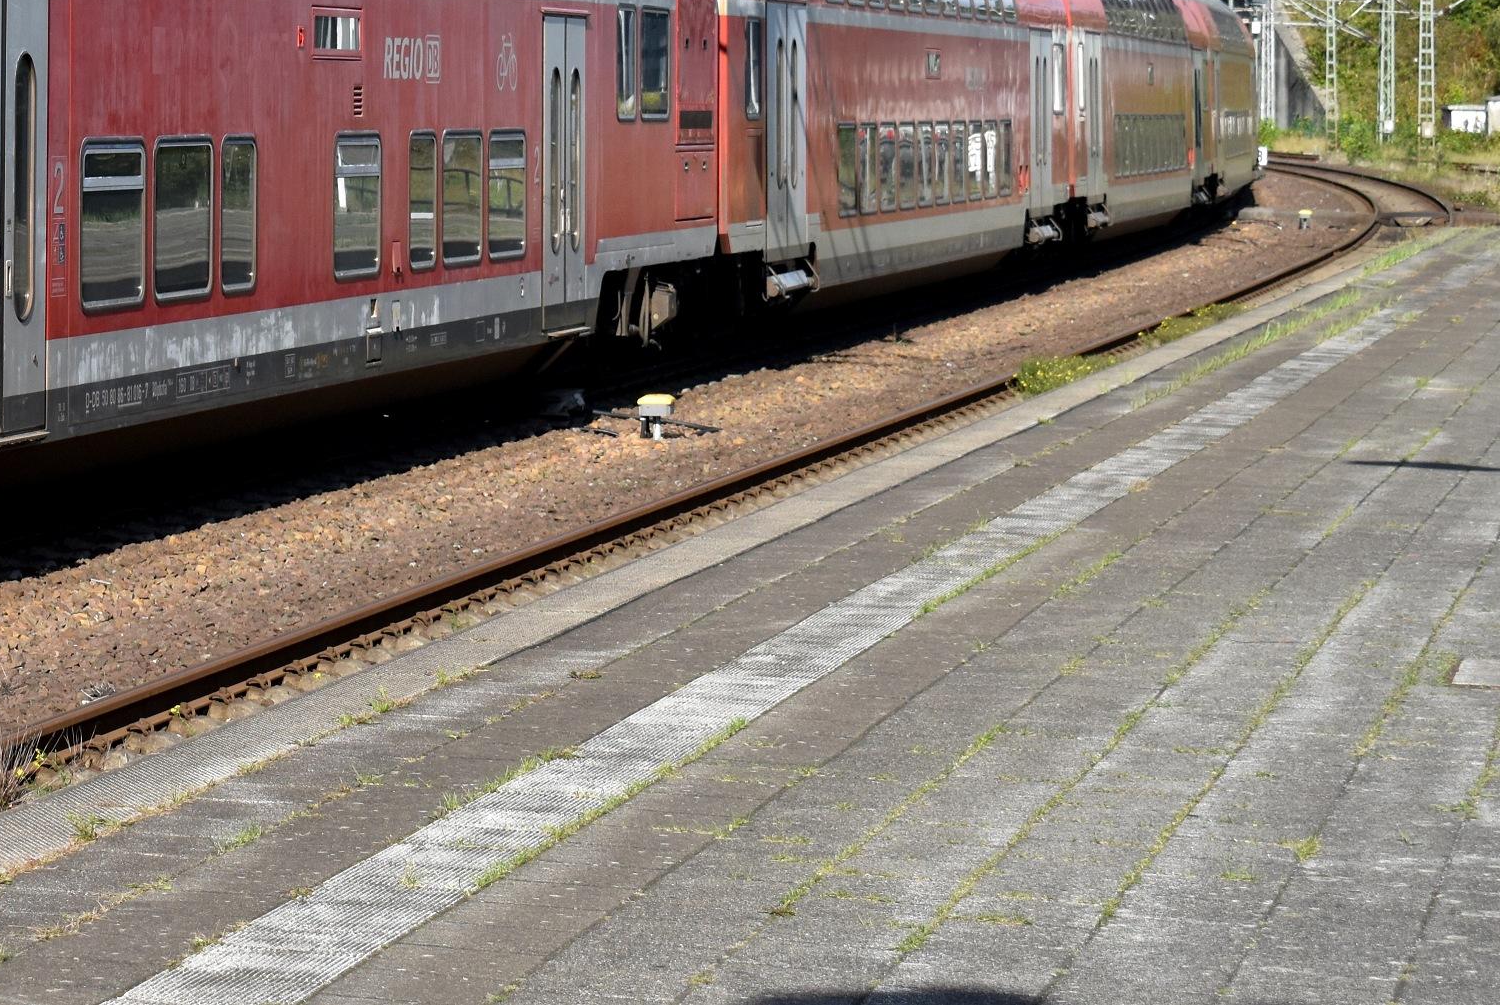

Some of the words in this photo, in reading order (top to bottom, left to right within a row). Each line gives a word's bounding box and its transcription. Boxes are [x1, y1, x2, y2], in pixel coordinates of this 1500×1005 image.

[384, 37, 423, 80] REGIO
[427, 40, 439, 77] DB
[54, 162, 64, 213] 2
